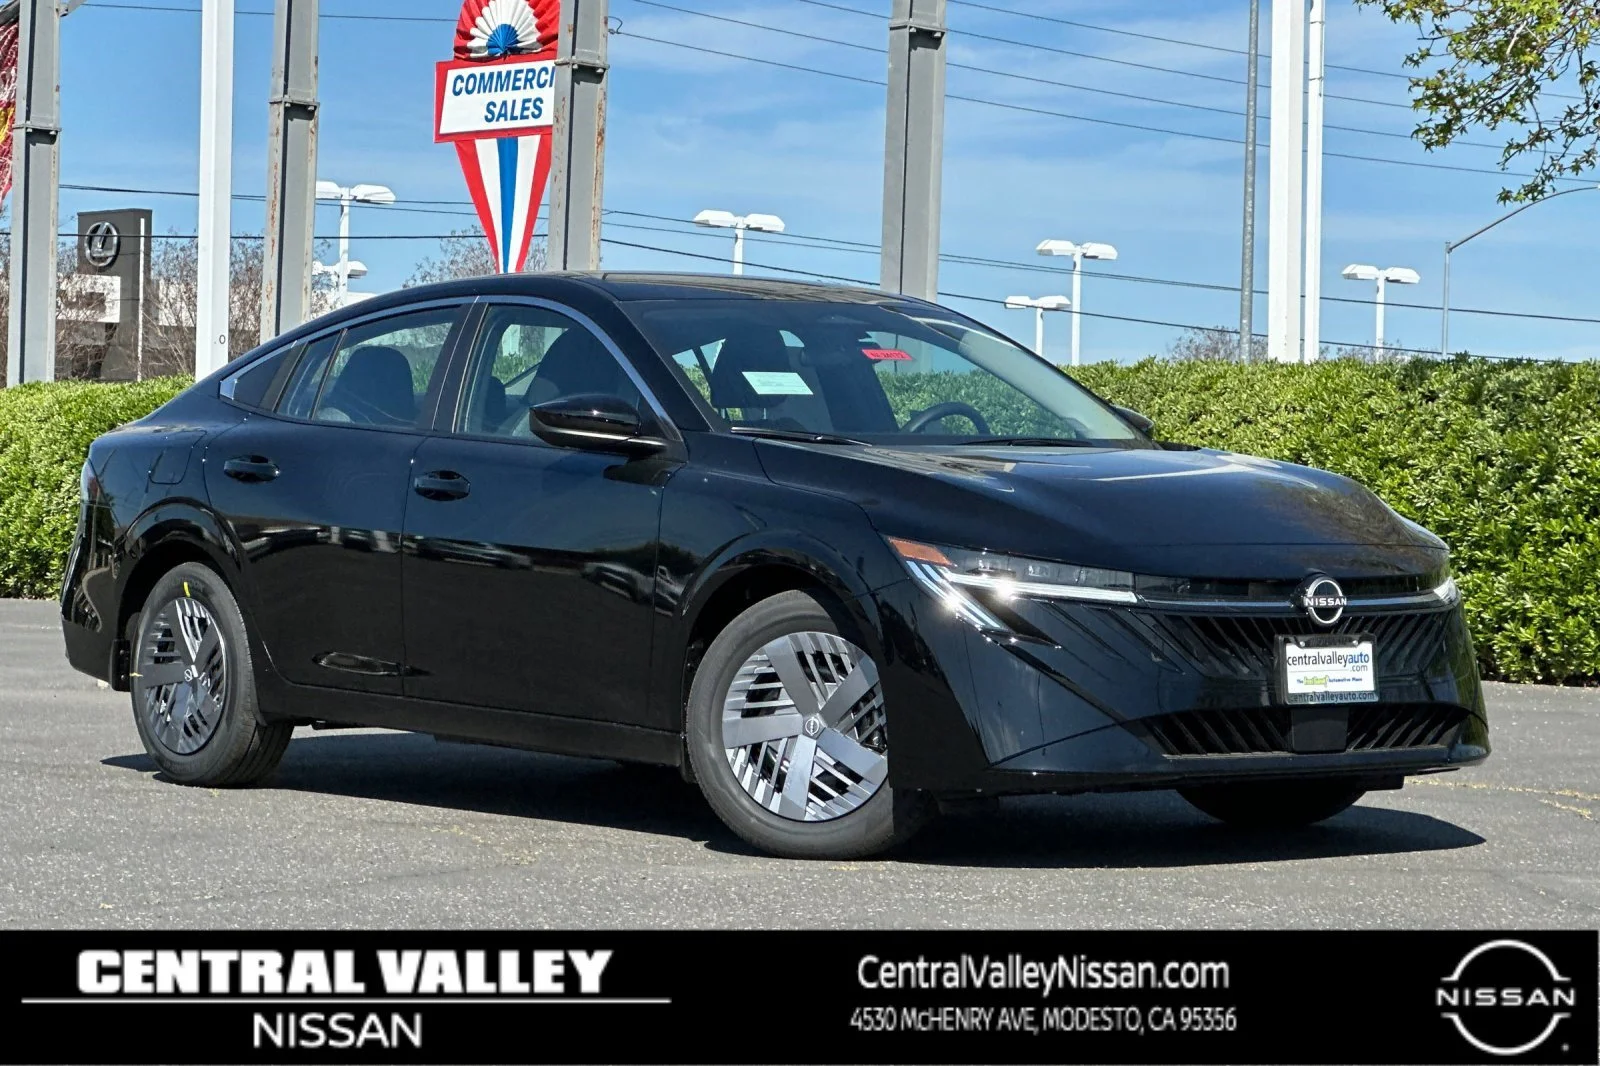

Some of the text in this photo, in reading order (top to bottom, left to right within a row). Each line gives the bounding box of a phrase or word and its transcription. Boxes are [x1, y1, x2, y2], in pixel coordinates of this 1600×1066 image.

[484, 97, 544, 123] SALES
[1305, 597, 1347, 606] NISSAN
[1287, 651, 1370, 668] centralvalleyauto
